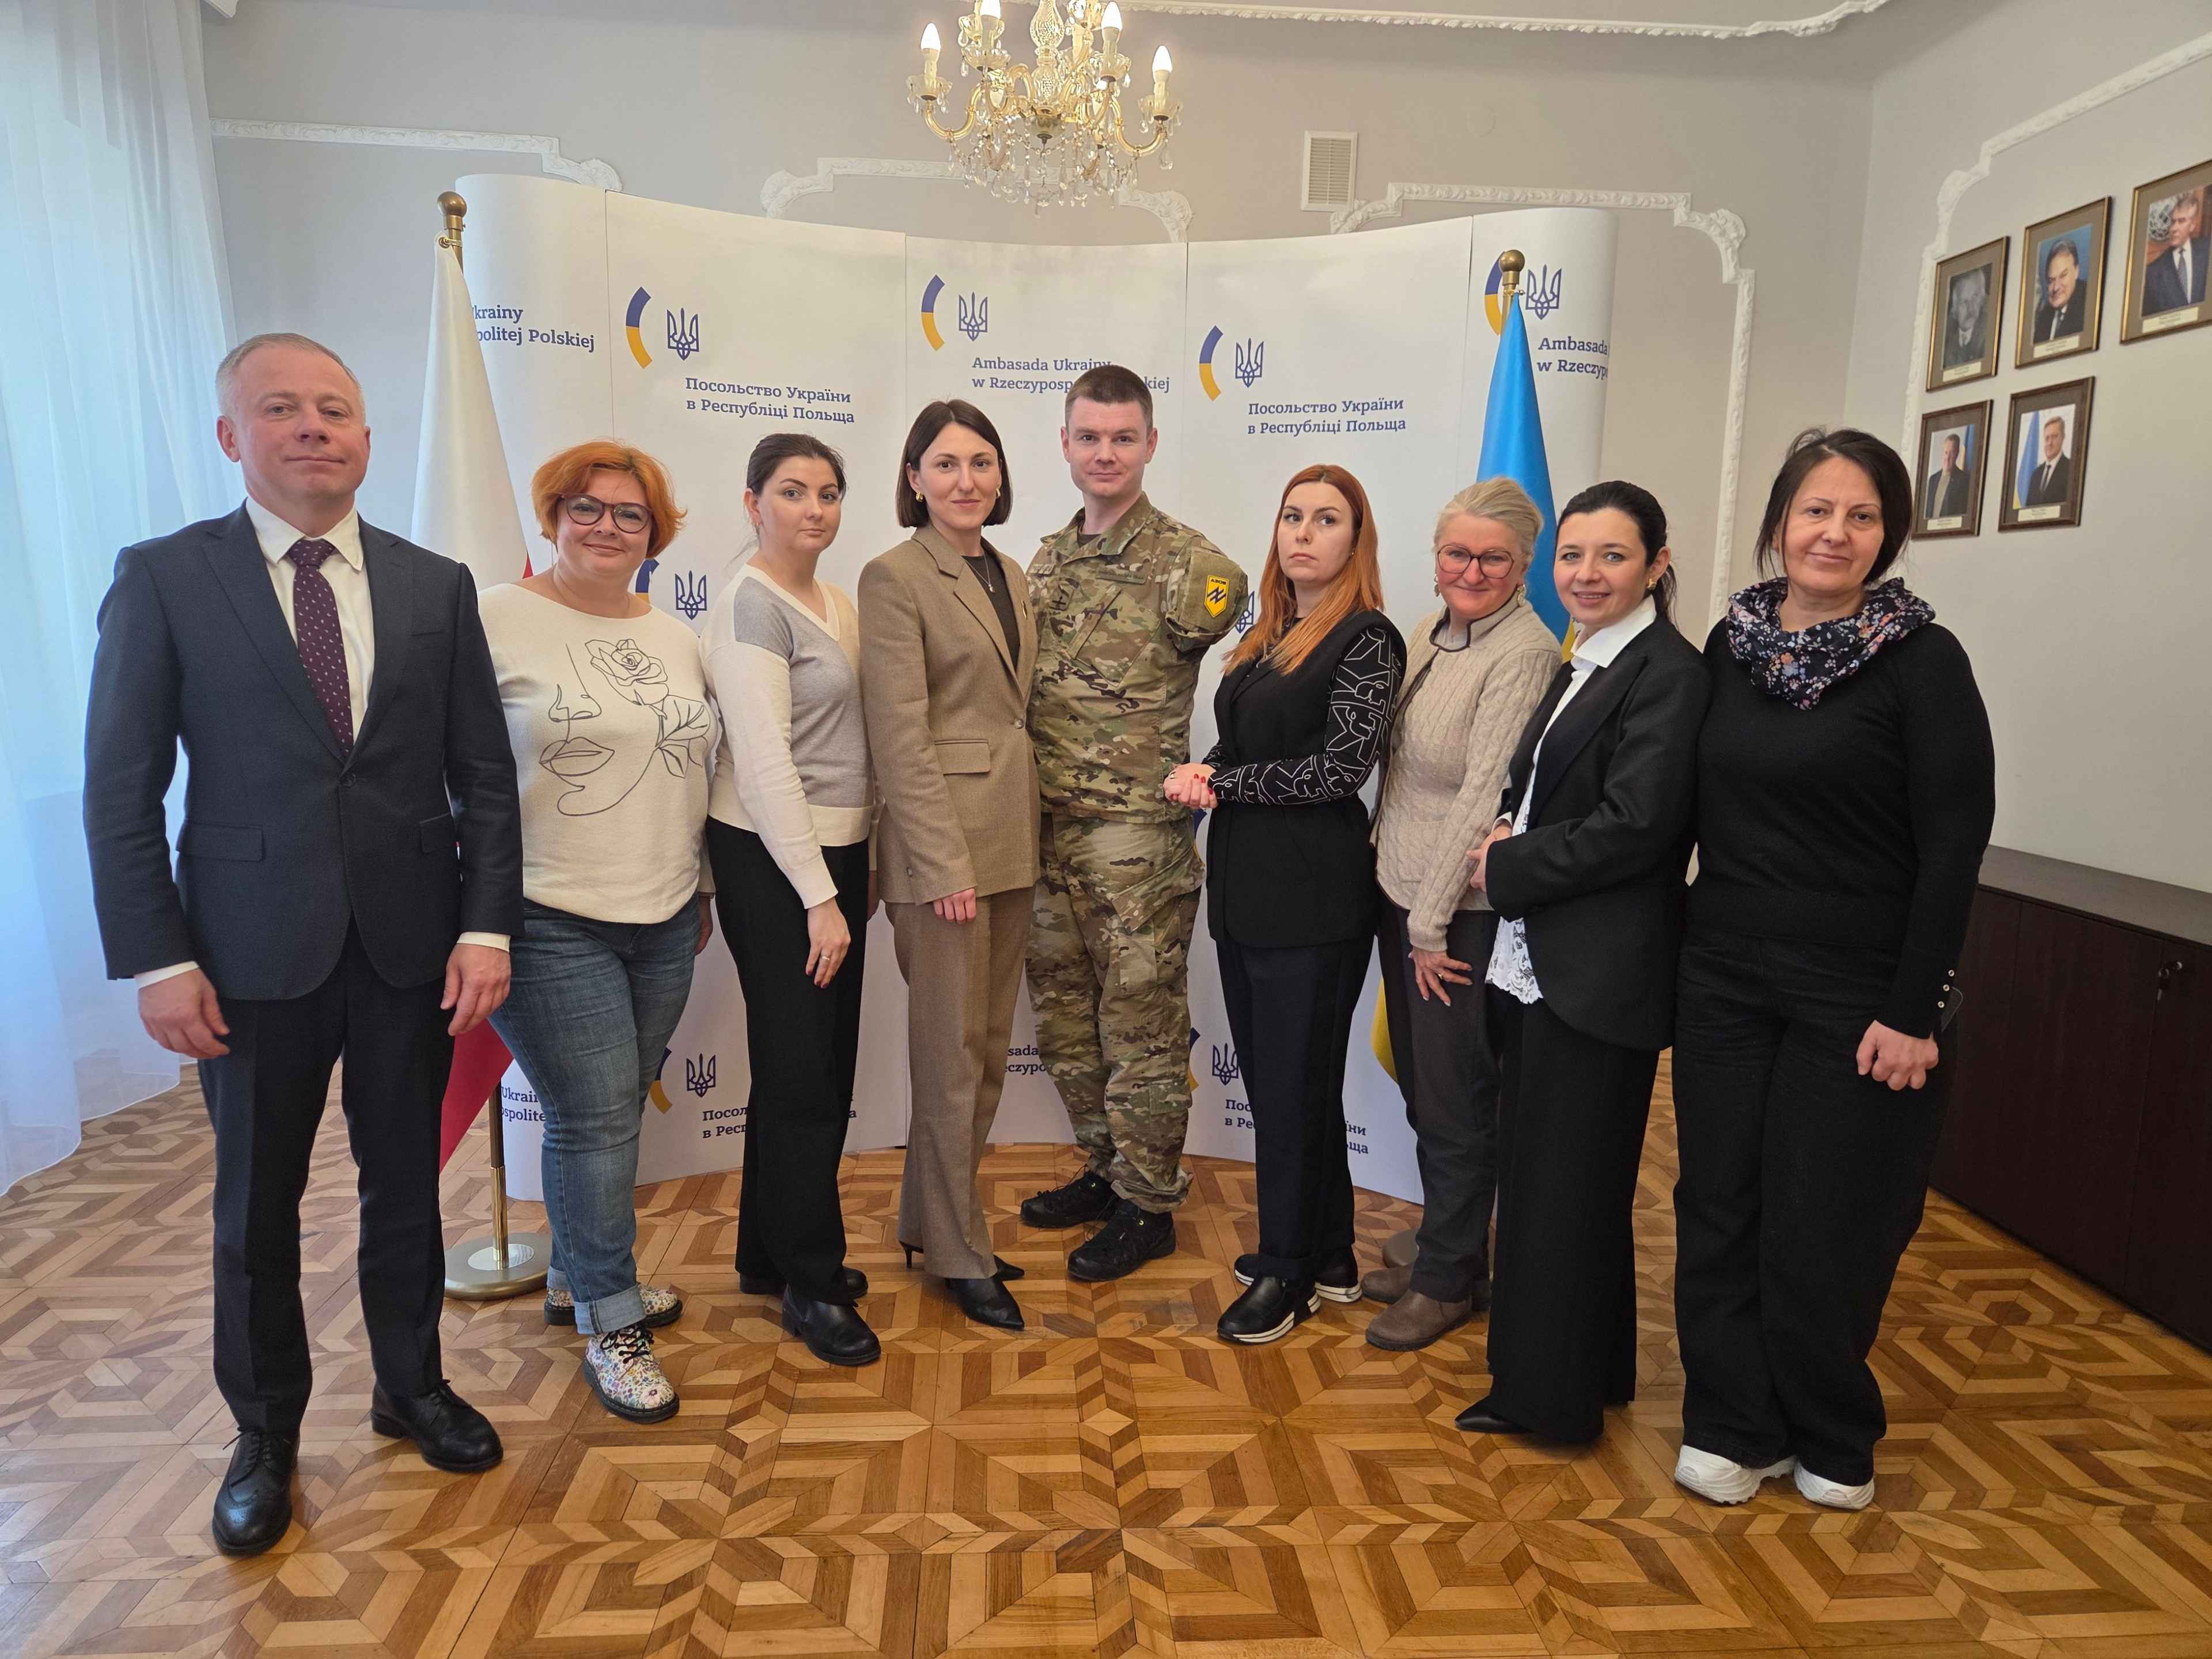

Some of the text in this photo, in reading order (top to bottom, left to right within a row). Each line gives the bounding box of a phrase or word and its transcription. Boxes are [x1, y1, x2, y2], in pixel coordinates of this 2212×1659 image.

[472, 304, 524, 324] krainy
[528, 329, 594, 353] Polskiej
[1538, 336, 1607, 355] Ambasada
[972, 357, 1048, 371] Ambasada
[1537, 362, 1552, 372] w
[685, 377, 851, 403] Посольство України
[972, 378, 985, 388] w
[687, 399, 855, 424] в Республіці Польща
[1248, 397, 1404, 415] Посольство України
[1248, 419, 1406, 437] в Республіці Польща
[702, 1130, 711, 1138] в
